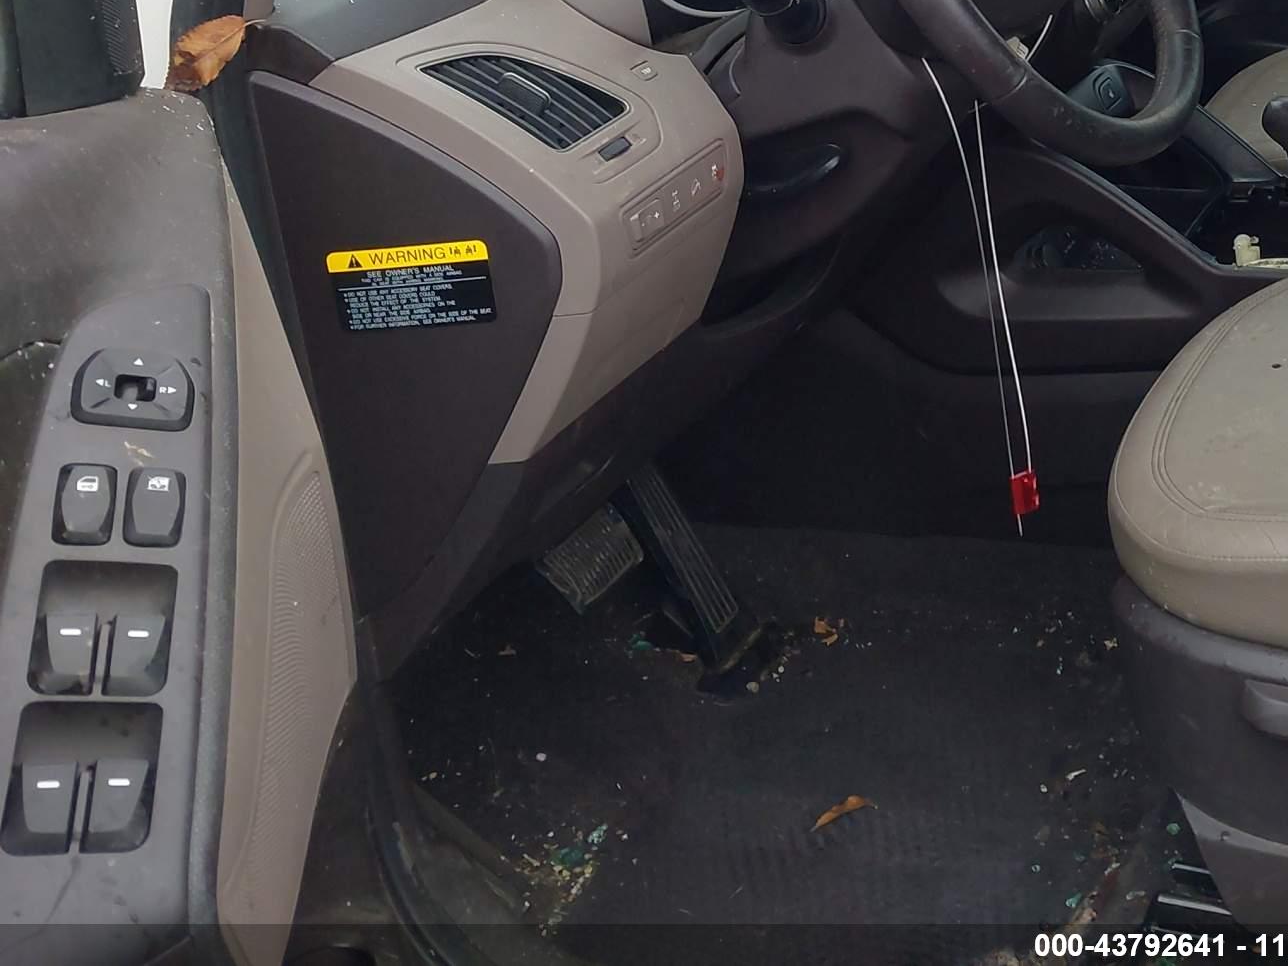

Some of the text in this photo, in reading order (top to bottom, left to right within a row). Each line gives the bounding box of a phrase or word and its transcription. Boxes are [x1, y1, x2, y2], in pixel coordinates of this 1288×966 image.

[368, 247, 446, 265] WARNING
[385, 268, 420, 276] OWNER'S
[423, 265, 454, 273] MANUAL
